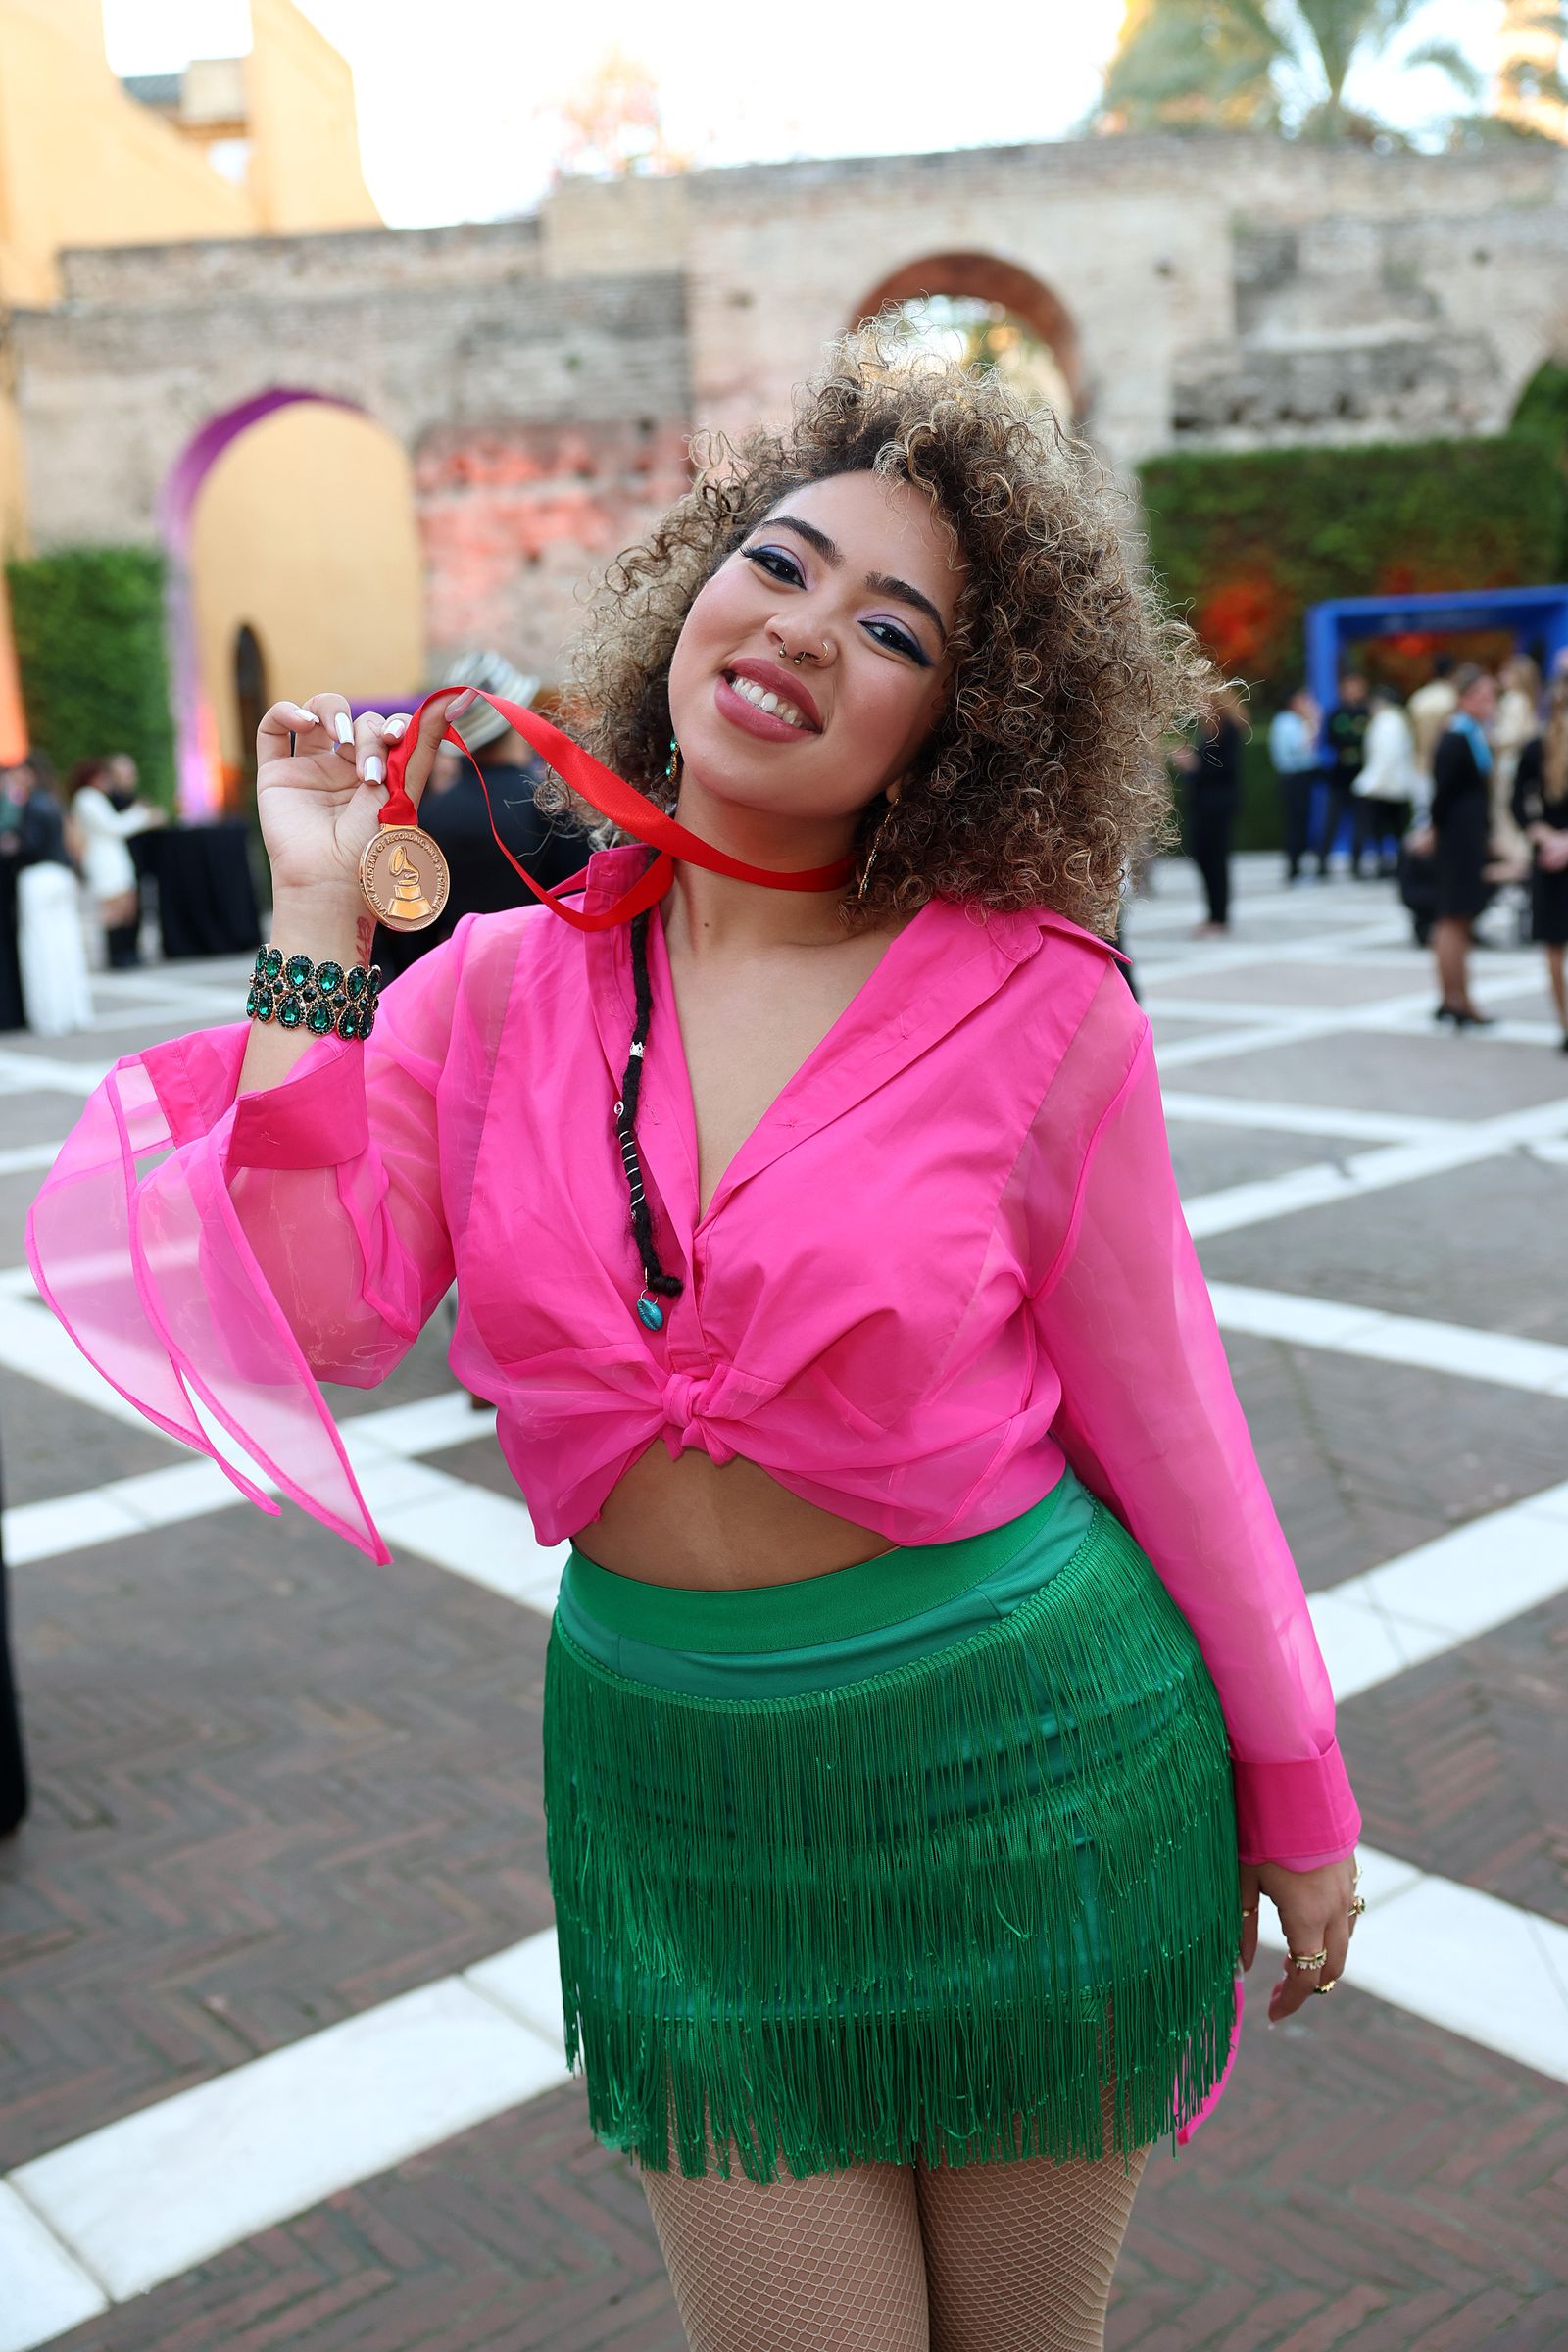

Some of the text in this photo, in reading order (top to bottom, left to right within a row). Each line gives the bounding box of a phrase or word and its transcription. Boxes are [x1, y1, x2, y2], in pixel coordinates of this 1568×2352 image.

[367, 852, 378, 893] ACADEMY
[376, 840, 386, 853] OF
[386, 832, 426, 848] RECORDING
